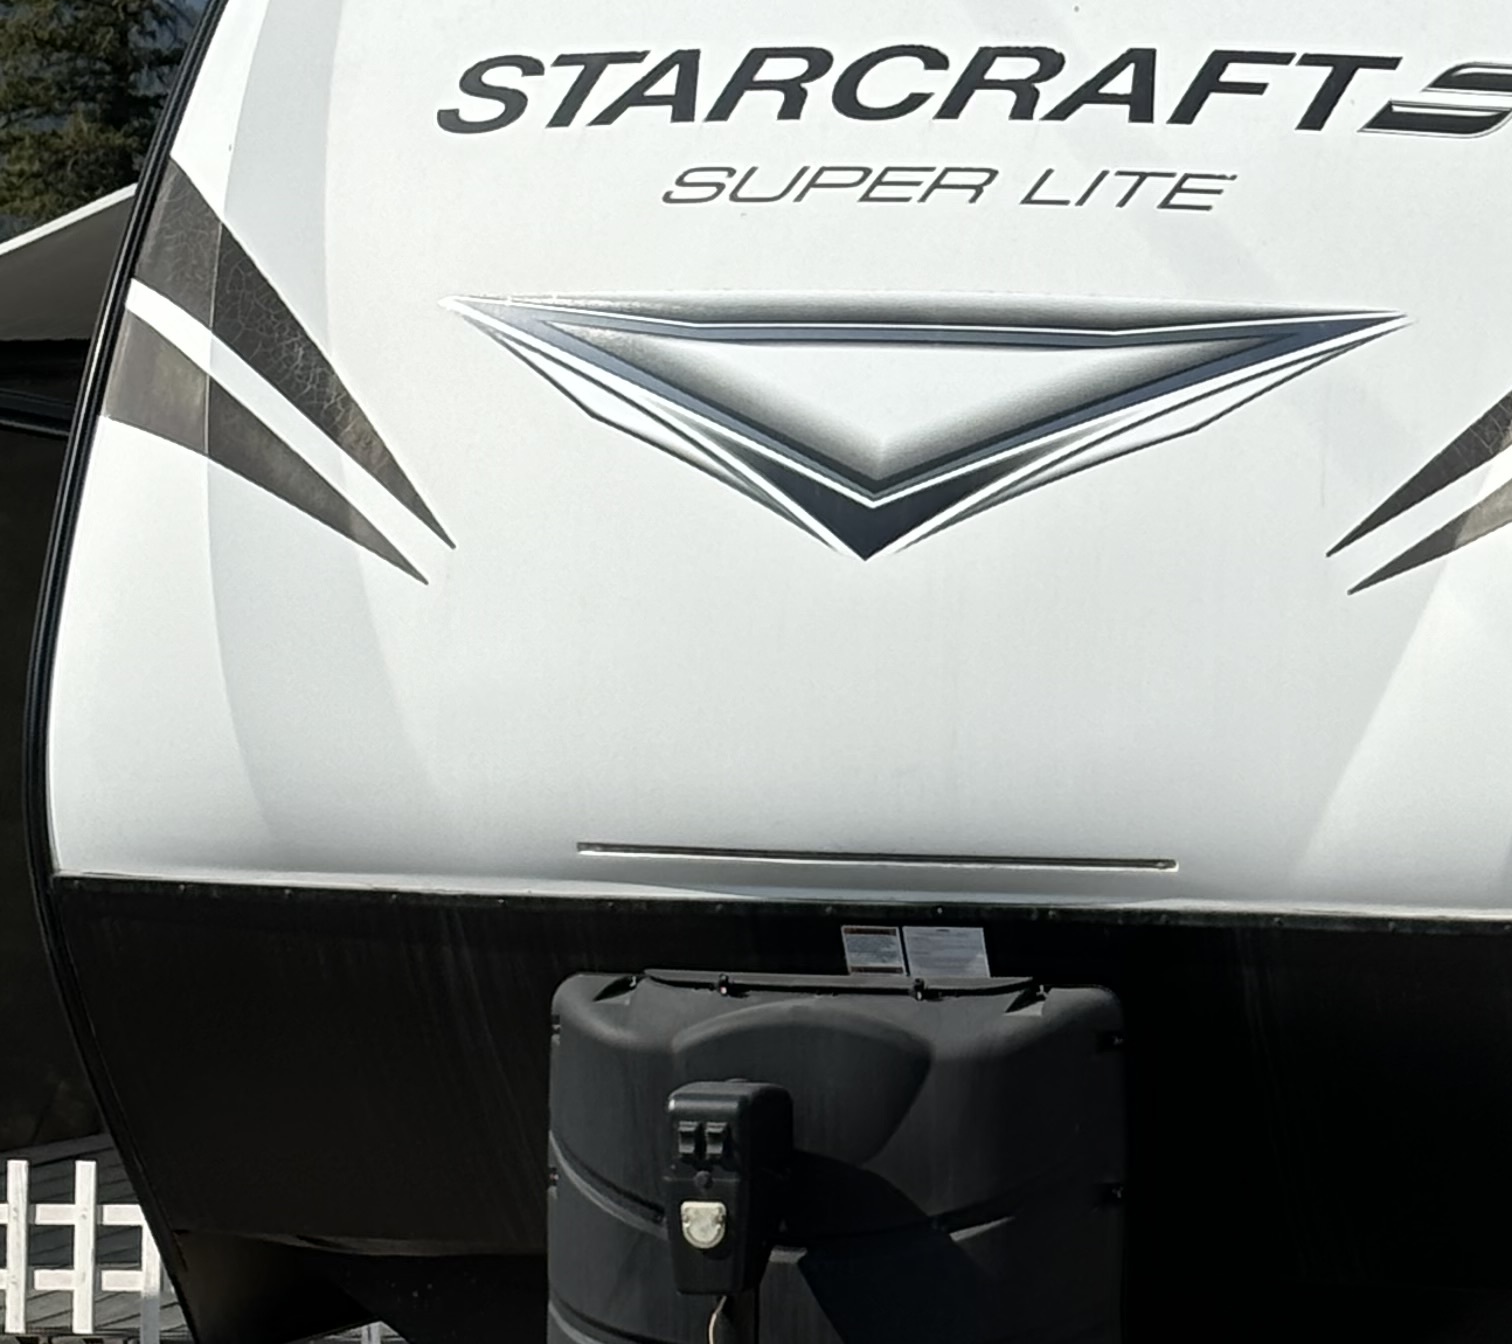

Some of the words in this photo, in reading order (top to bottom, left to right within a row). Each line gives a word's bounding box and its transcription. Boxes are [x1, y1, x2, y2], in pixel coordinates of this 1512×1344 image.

[436, 45, 1404, 135] STARCRAFT
[661, 166, 999, 204] SUPER
[1020, 168, 1238, 211] LITE
